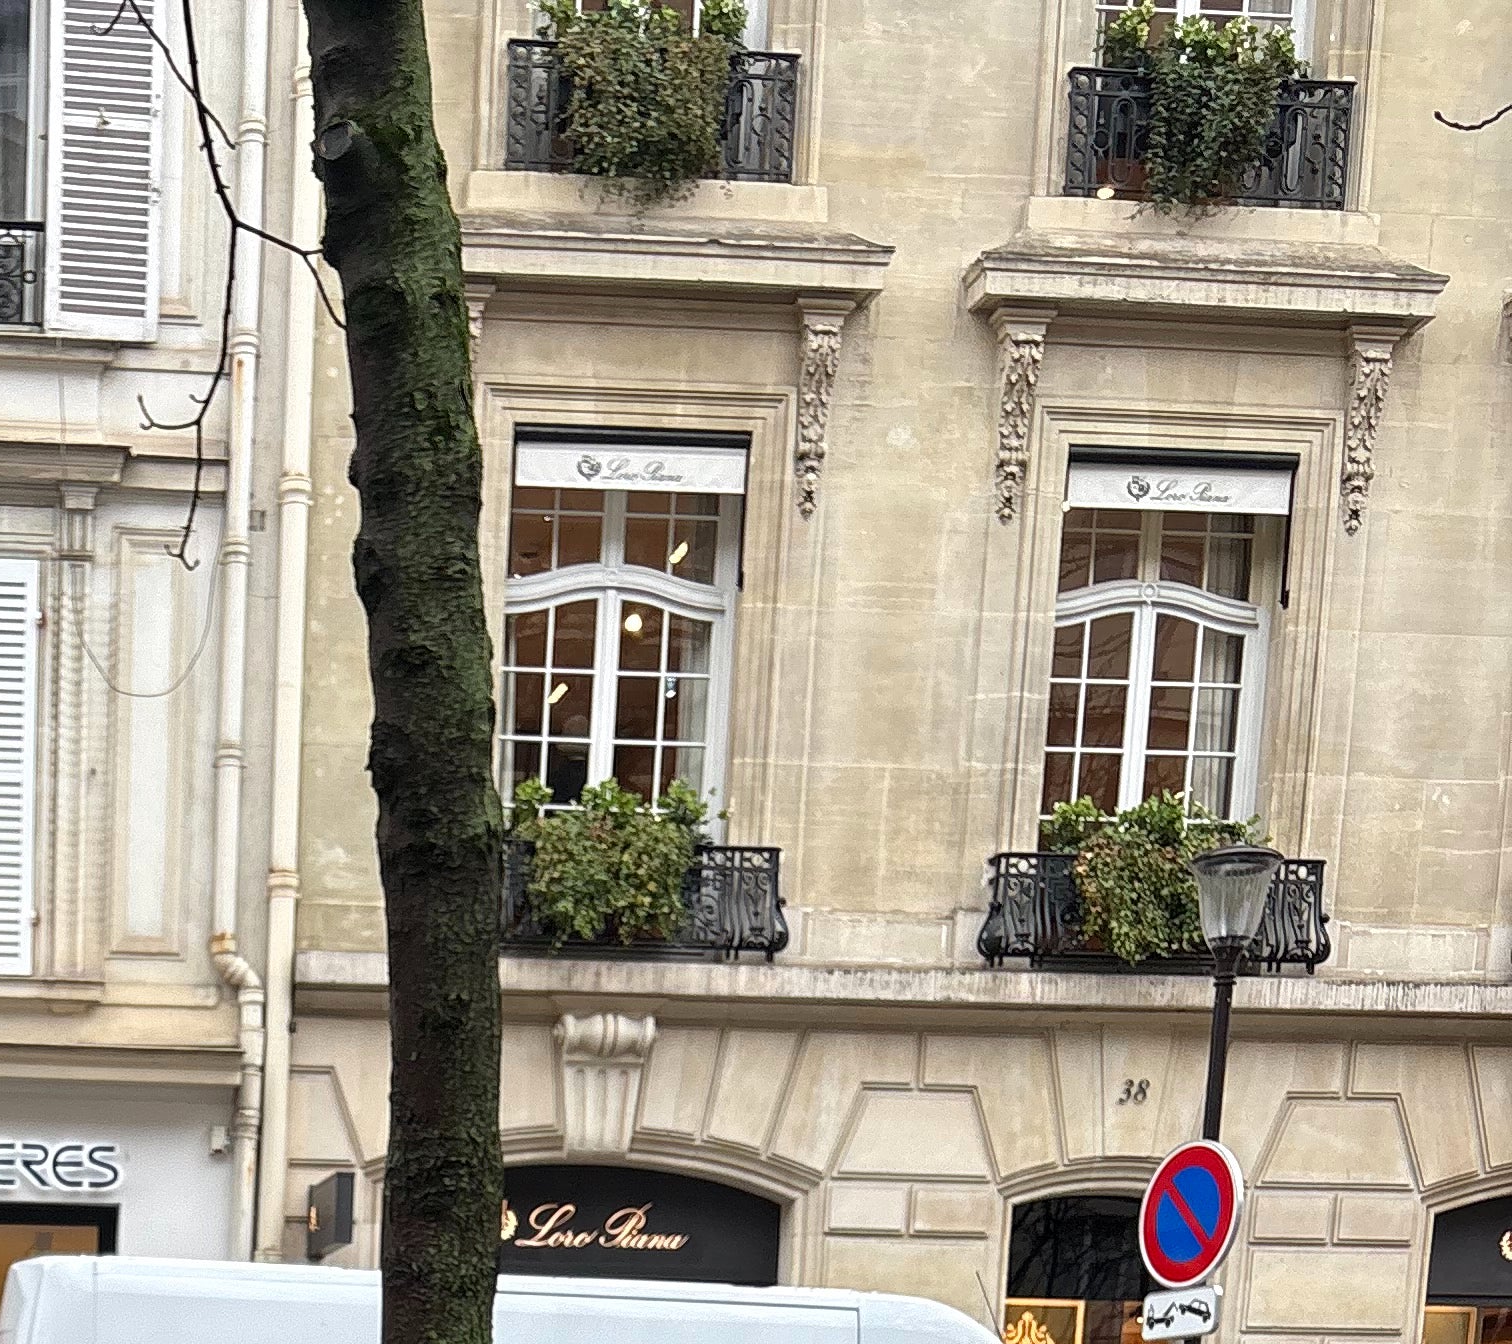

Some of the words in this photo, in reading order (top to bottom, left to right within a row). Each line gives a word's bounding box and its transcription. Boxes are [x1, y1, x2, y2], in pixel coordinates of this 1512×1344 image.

[1116, 1078, 1150, 1105] 38
[514, 1202, 598, 1248] Loro
[599, 1201, 689, 1250] Piana
